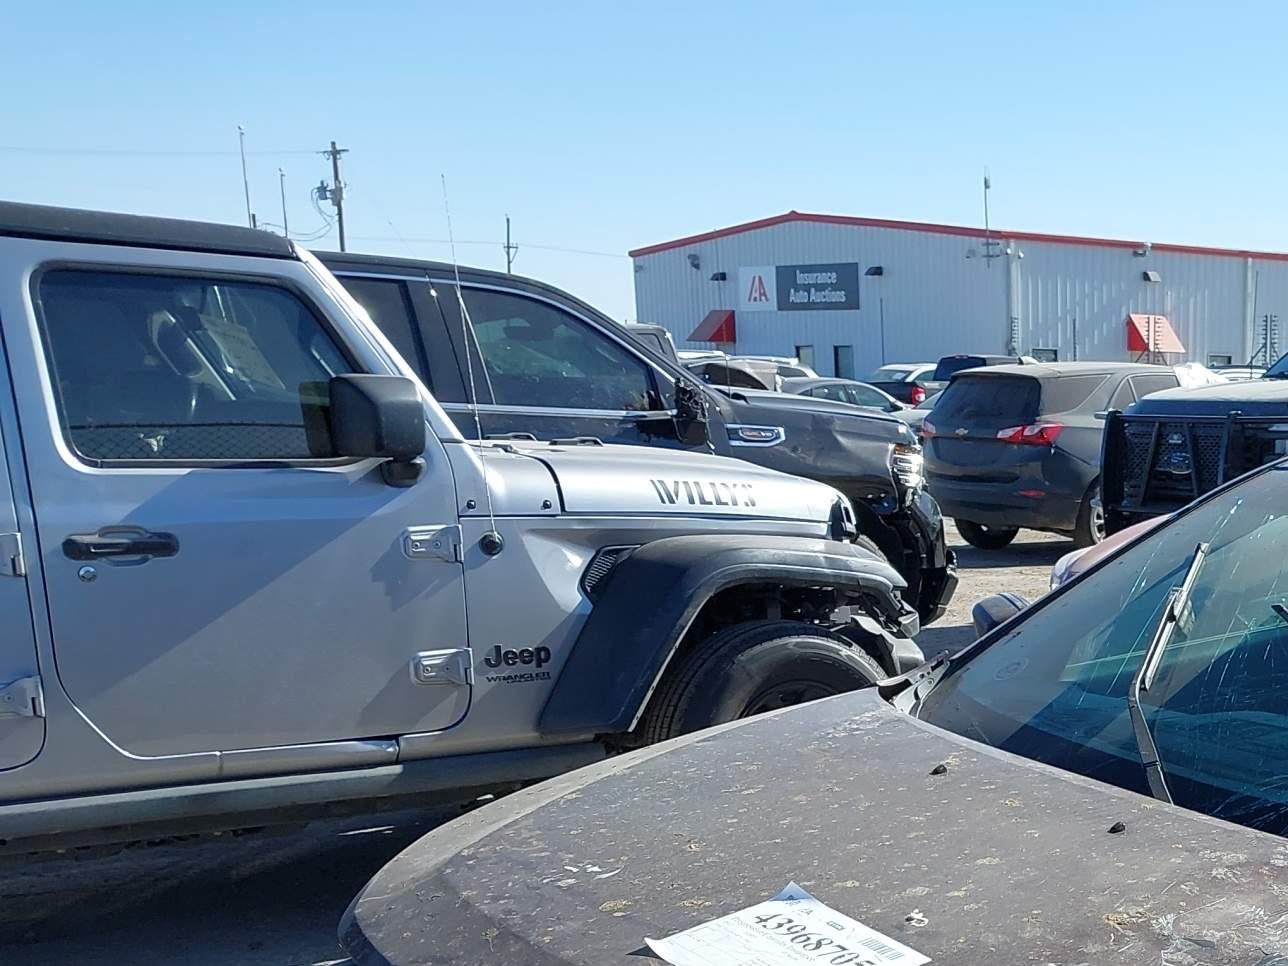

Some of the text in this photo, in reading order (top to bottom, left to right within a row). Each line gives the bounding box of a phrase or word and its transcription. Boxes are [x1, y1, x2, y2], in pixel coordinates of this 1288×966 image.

[796, 269, 837, 284] Insurance
[789, 287, 846, 303] Auto Auctions
[649, 479, 757, 507] WILLYS
[484, 643, 552, 669] Jeep
[486, 671, 552, 683] WRANGLER
